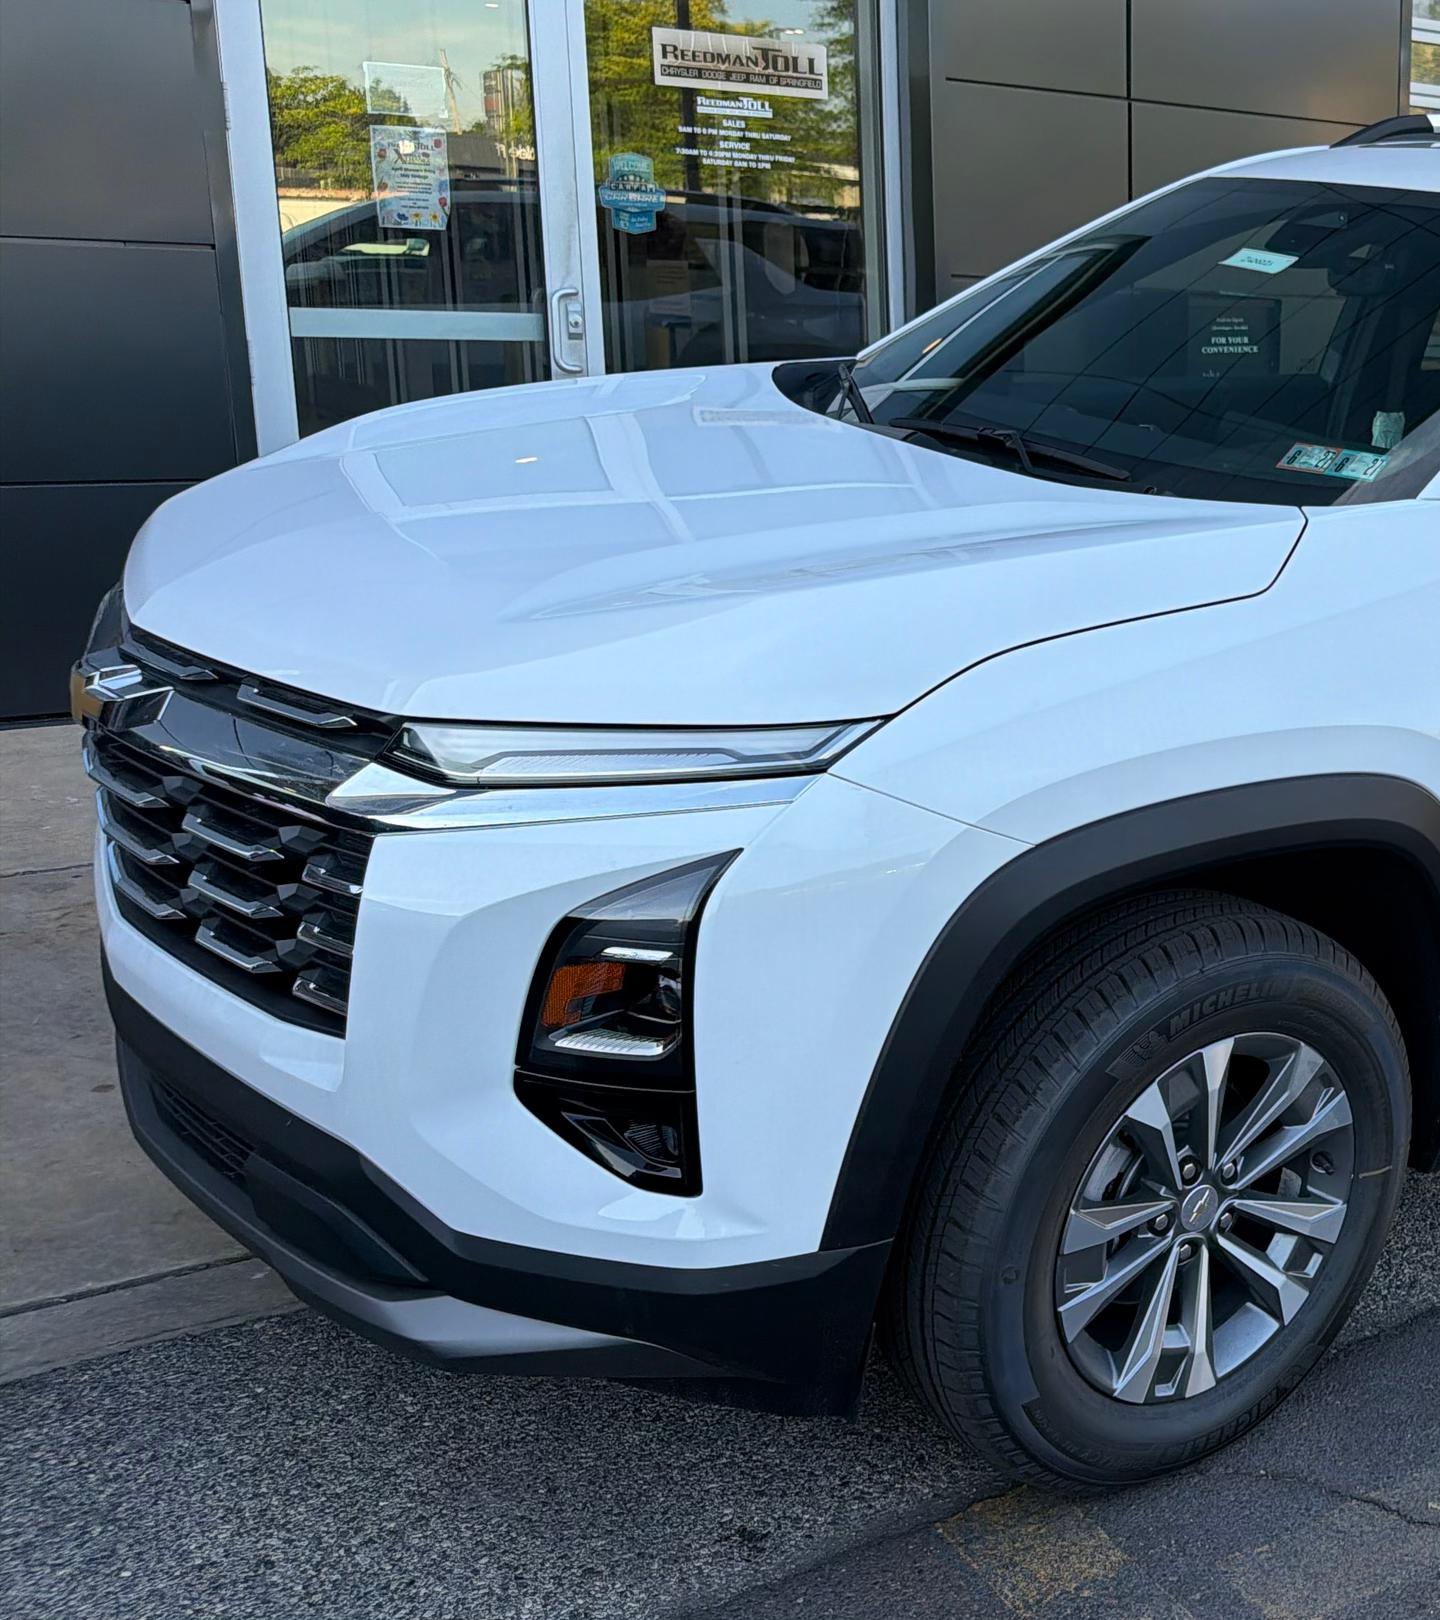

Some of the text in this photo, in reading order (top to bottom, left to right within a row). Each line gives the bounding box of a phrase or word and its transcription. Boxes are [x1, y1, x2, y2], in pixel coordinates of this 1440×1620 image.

[661, 65, 822, 89] CHRYSLER DODGE JEEP RAM OF SPRINGFIELD
[722, 119, 746, 128] SALES
[719, 129, 744, 137] MONDAY
[762, 132, 791, 141] SATURDAY
[720, 141, 750, 150] SERVICE
[702, 158, 732, 166] SATURDAY
[732, 152, 757, 160] MONDAY
[775, 155, 795, 163] FRIDAY
[1211, 336, 1248, 344] FOR YOUR
[1201, 346, 1259, 354] CONVENIENCE
[1169, 979, 1290, 1037] MICHELIN
